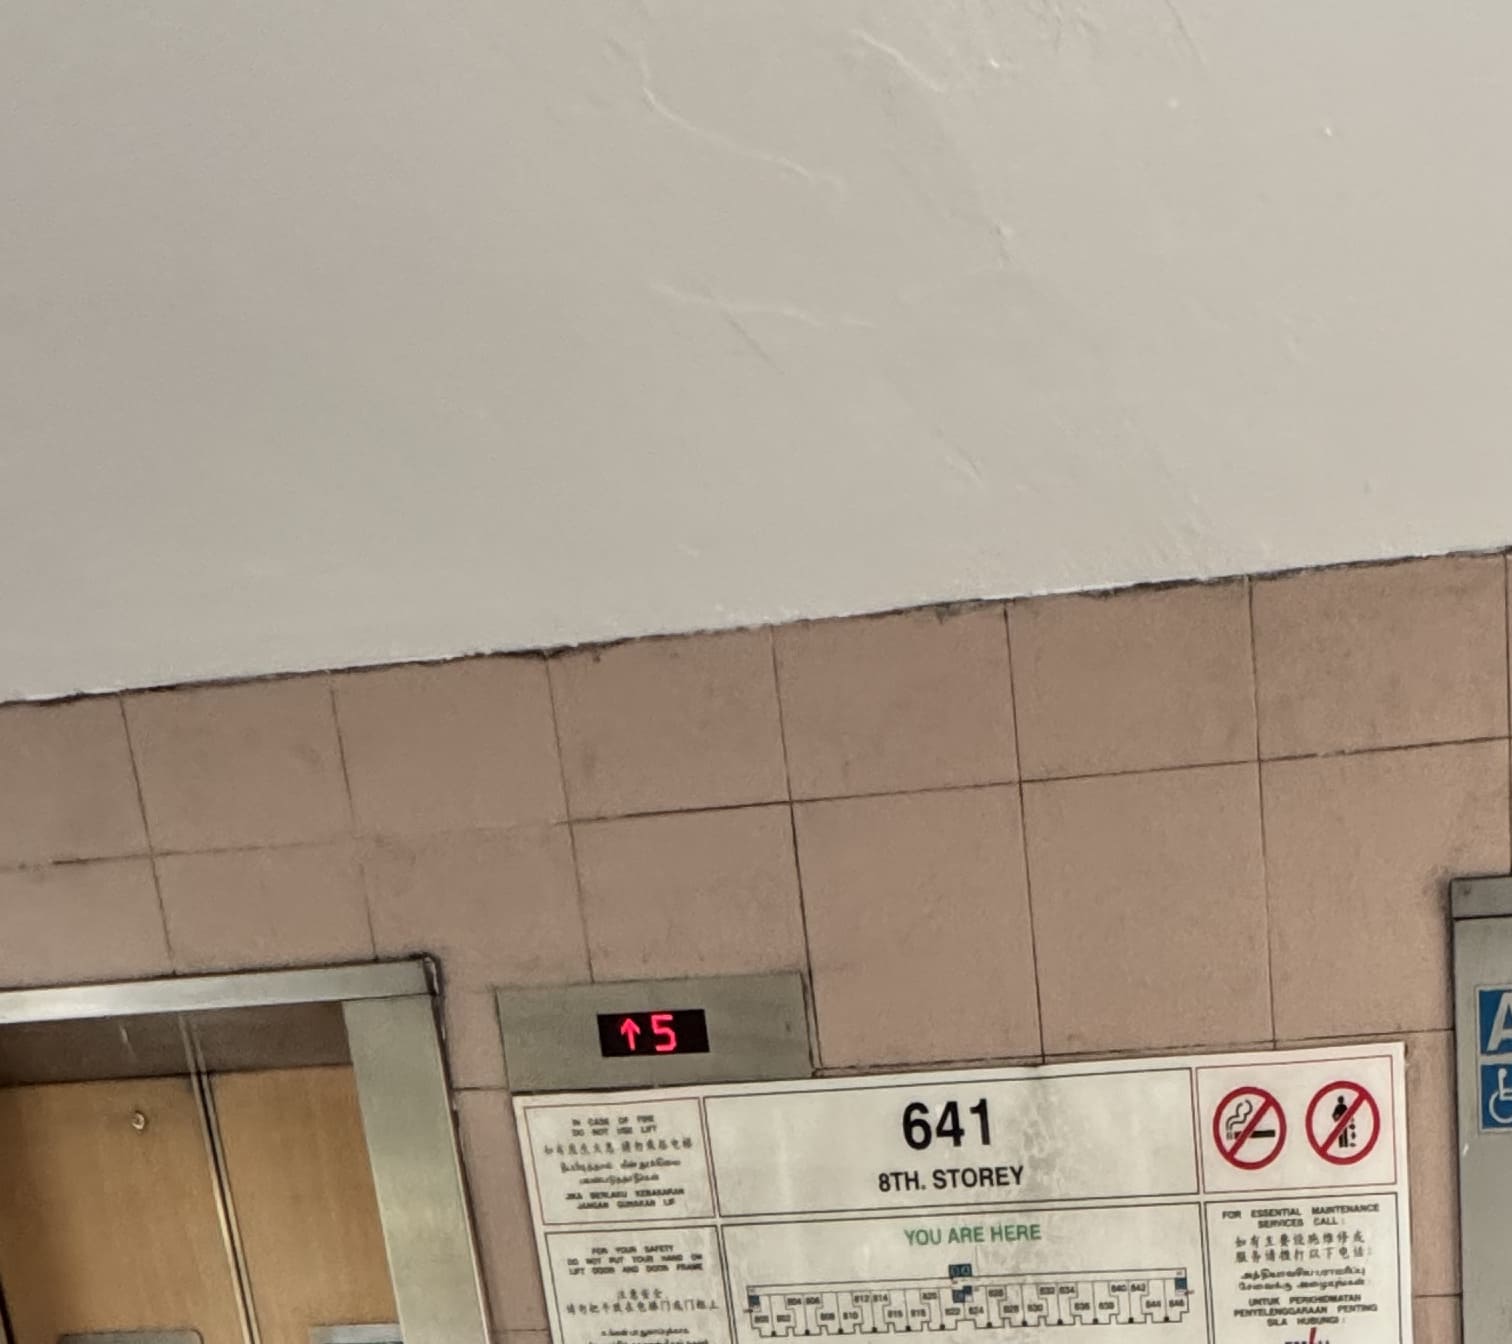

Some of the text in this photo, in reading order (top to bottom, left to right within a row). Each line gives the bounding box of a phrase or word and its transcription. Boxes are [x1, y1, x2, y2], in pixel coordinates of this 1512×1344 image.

[651, 1014, 677, 1052] 5
[902, 1098, 991, 1151] 641
[878, 1165, 1024, 1192] 8TH. STOREY
[1222, 1203, 1380, 1219] FOR ESSENTIAL MAINTENANCE
[1258, 1218, 1304, 1229] SERVICES
[904, 1224, 1042, 1247] YOU ARE HERE
